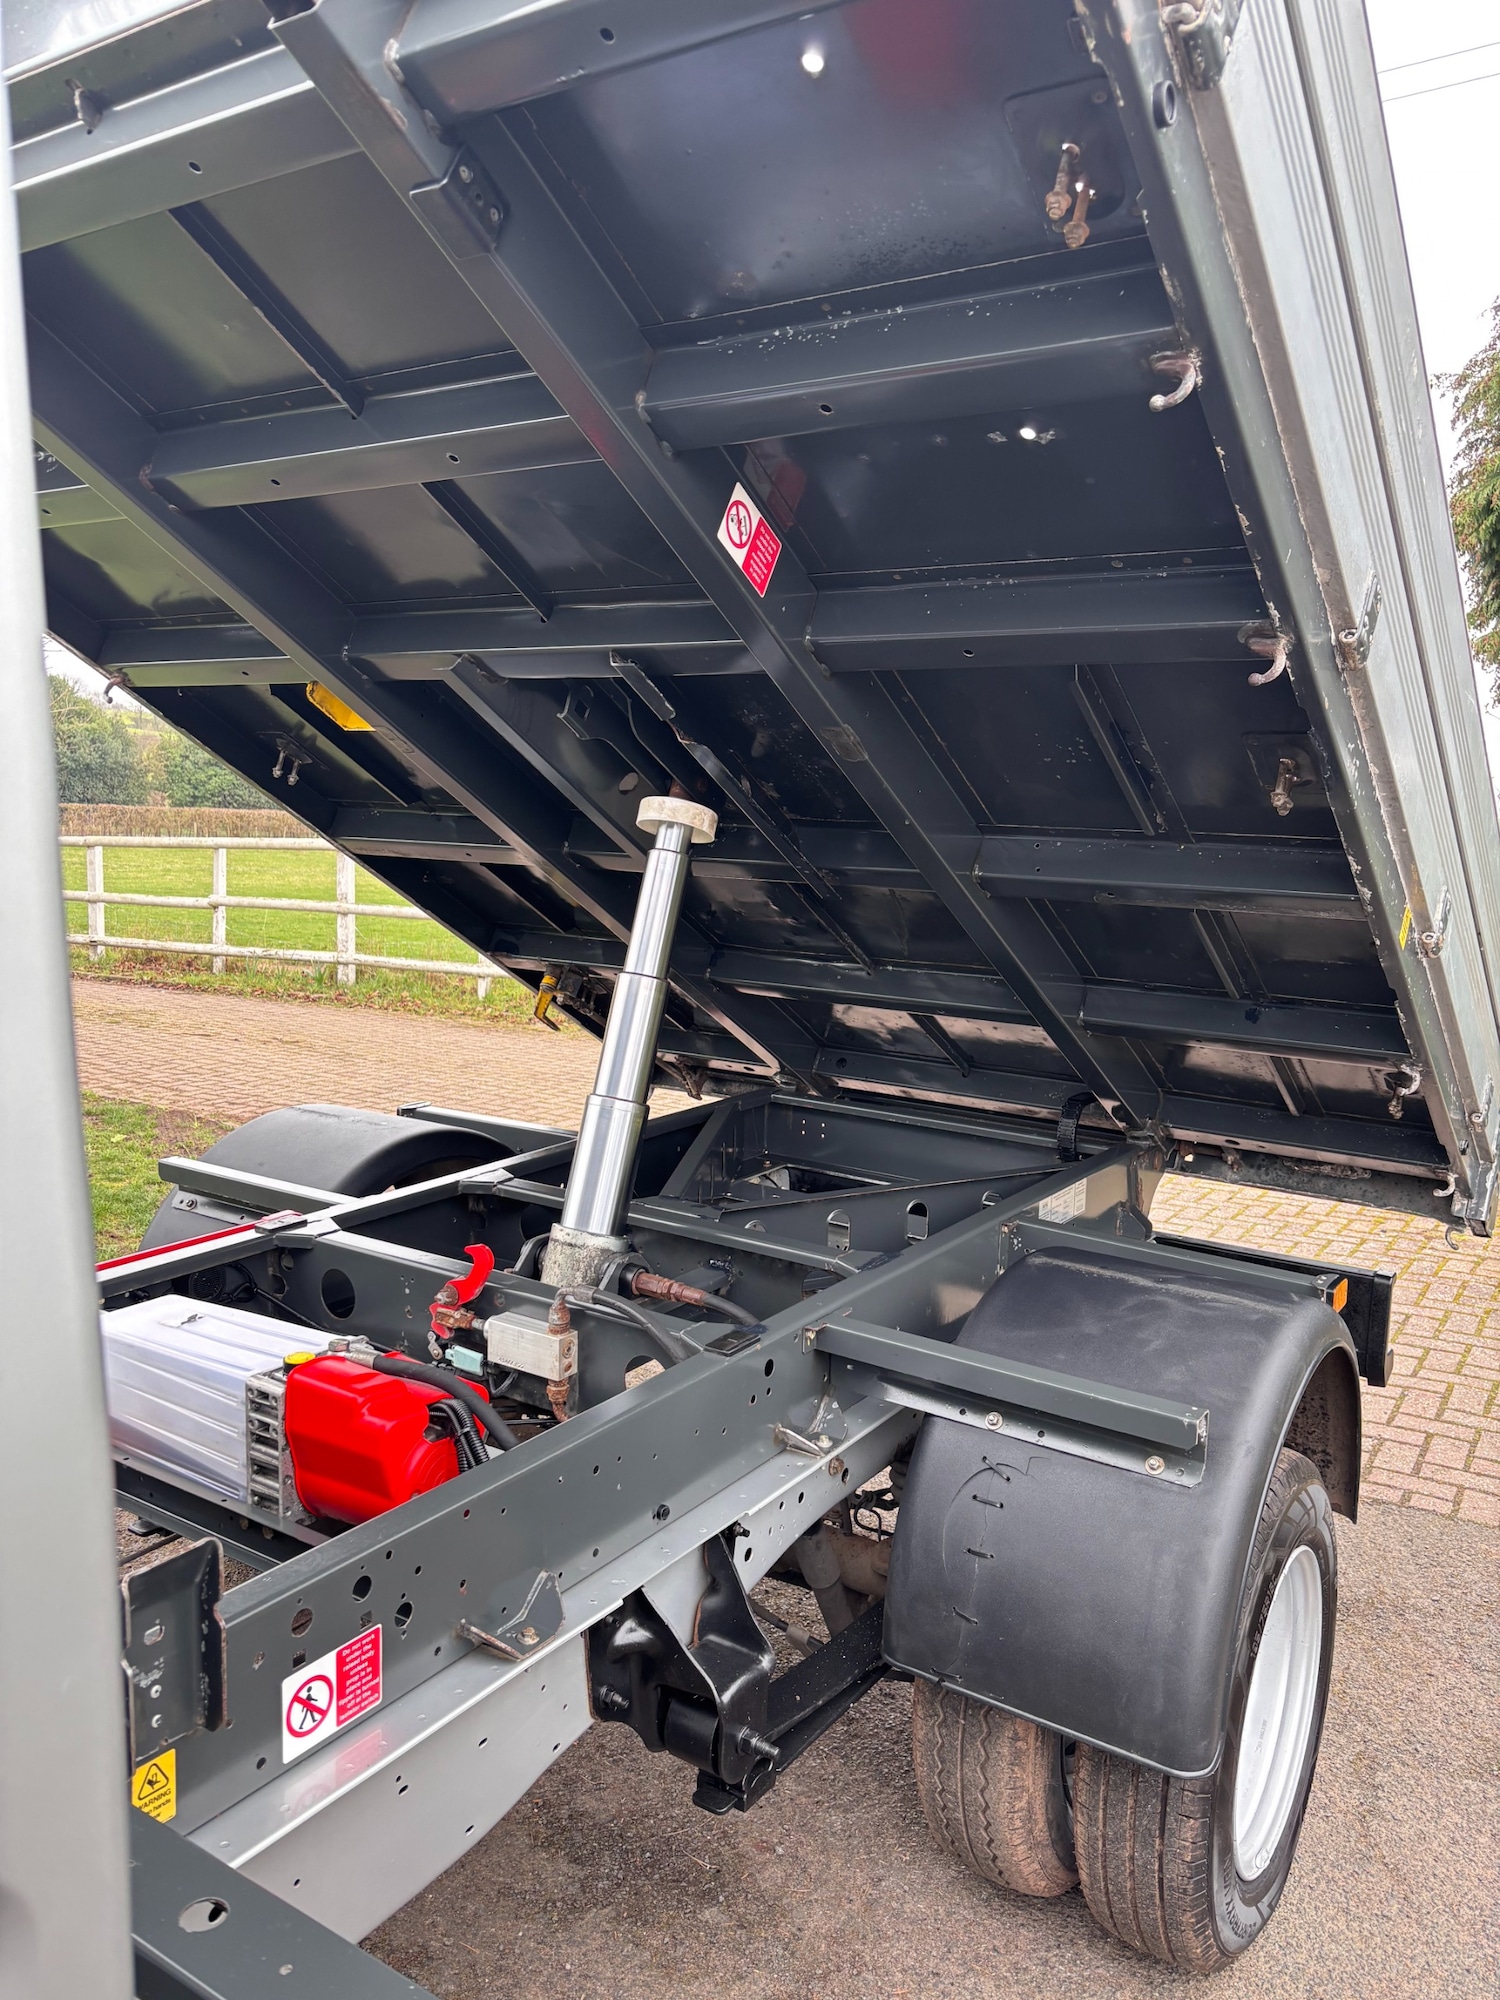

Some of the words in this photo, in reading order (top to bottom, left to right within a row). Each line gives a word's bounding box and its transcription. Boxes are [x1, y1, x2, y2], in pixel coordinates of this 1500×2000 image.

[342, 1648, 350, 1657] Do
[352, 1642, 361, 1651] not
[362, 1633, 375, 1645] work
[346, 1649, 362, 1662] under
[363, 1643, 372, 1652] the
[343, 1657, 360, 1672] raised
[361, 1649, 375, 1661] body
[350, 1661, 368, 1675] unless
[346, 1675, 359, 1687] prop
[346, 1680, 361, 1695] place
[362, 1673, 372, 1684] and
[362, 1676, 380, 1690] turned
[339, 1704, 360, 1721] isolator
[361, 1692, 379, 1707] switch
[347, 1699, 355, 1709] off
[356, 1696, 362, 1704] at
[362, 1690, 372, 1699] the
[153, 1798, 171, 1812] hands
